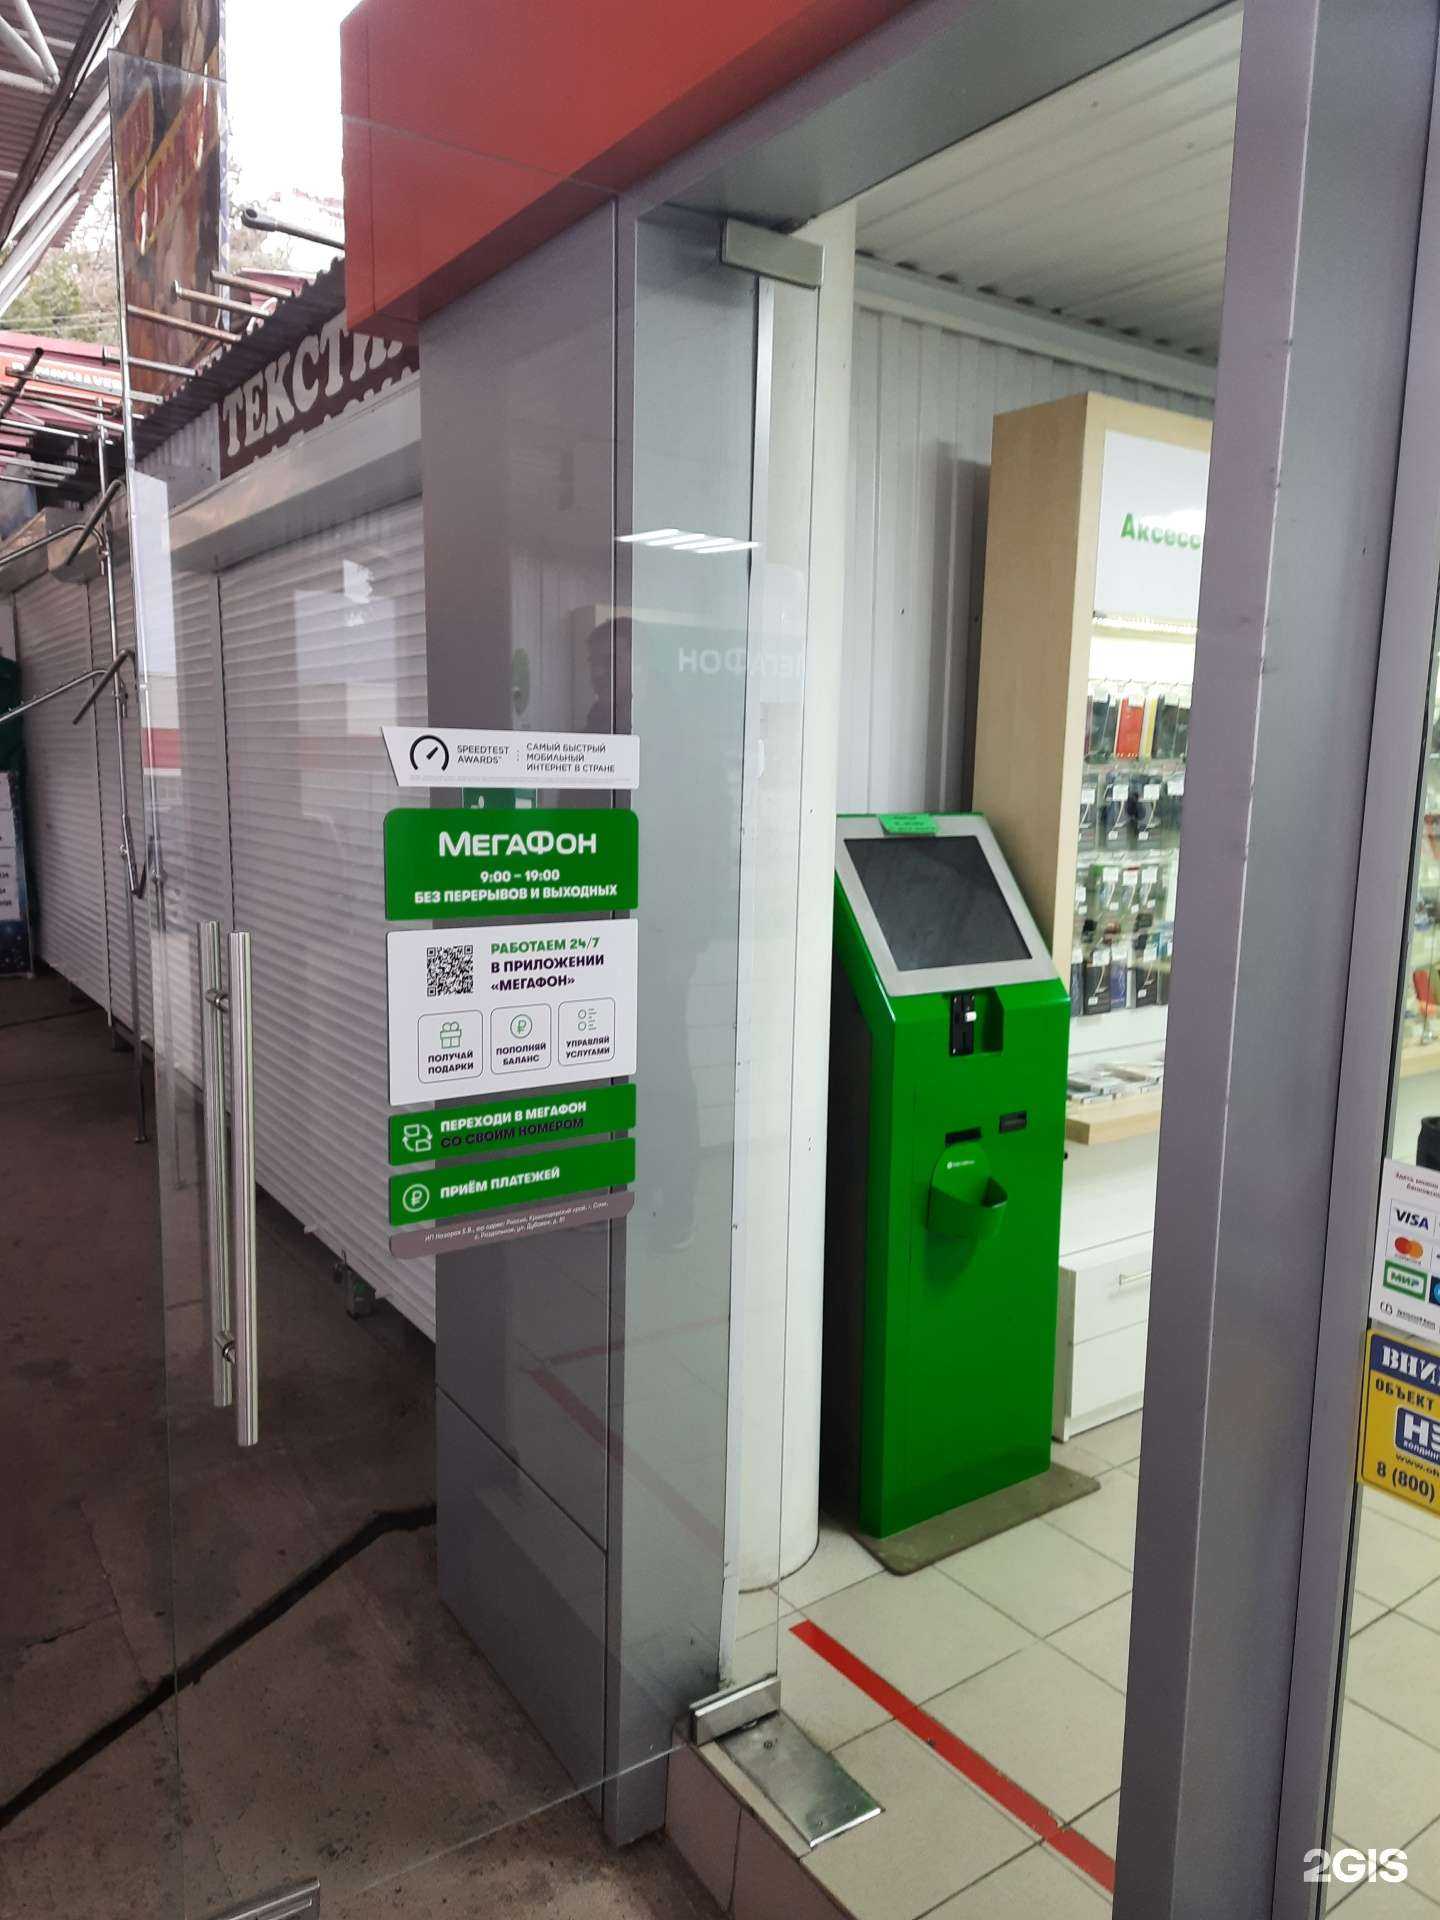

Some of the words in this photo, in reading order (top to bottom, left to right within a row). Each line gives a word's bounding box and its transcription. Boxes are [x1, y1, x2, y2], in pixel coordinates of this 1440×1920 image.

[223, 311, 403, 456] ТЕКСТИ
[457, 744, 509, 755] SPEEDTEST
[526, 742, 560, 752] САМЫЙ
[563, 743, 606, 753] БЫСТРЫЙ
[526, 752, 585, 762] МОБИЛЬНЫЙ
[526, 763, 572, 772] ИНТЕРНЕТ
[575, 764, 581, 772] В
[583, 764, 616, 773] СТРАНЕ
[480, 869, 511, 883] 9:00
[525, 869, 560, 882] 19:00
[415, 891, 441, 904] БЕЗ
[444, 887, 528, 902] ПЕРЕРЫВОВ
[530, 887, 540, 899] И
[543, 884, 618, 898] ВЫХОДНЫХ
[490, 939, 567, 955] РАБОТАЕМ
[569, 936, 601, 950] 24/7
[491, 961, 500, 974] В
[504, 954, 605, 973] ПРИЛОЖЕНИИ
[491, 975, 576, 992] «МЕГАФОН»
[496, 1042, 547, 1056] ПОПОЛНЯЙ
[566, 1035, 610, 1048] УПРАВЛЯЙ
[428, 1050, 474, 1063] ПОЛУЧАЙ
[503, 1054, 540, 1066] БАЛАНС
[566, 1047, 610, 1059] УСЛУГАМИ
[428, 1062, 474, 1075] ПОДАРКИ
[440, 1111, 511, 1133] ПЕРЕХОДИ
[514, 1110, 523, 1121] В
[526, 1101, 587, 1119] МЕГАФОН
[440, 1136, 462, 1149] СО
[519, 1118, 584, 1137] НОМЕРОМ
[440, 1180, 488, 1199] ПРИЁМ
[491, 1166, 561, 1189] ПЛАТЕЖЕЙ
[1395, 1209, 1429, 1231] VISA
[1390, 1271, 1420, 1288] МИР
[1382, 1345, 1440, 1387] ВНИ
[1375, 1377, 1434, 1412] ОБЪЕКТ
[1376, 1461, 1388, 1478] 8
[1392, 1467, 1436, 1504] (800)
